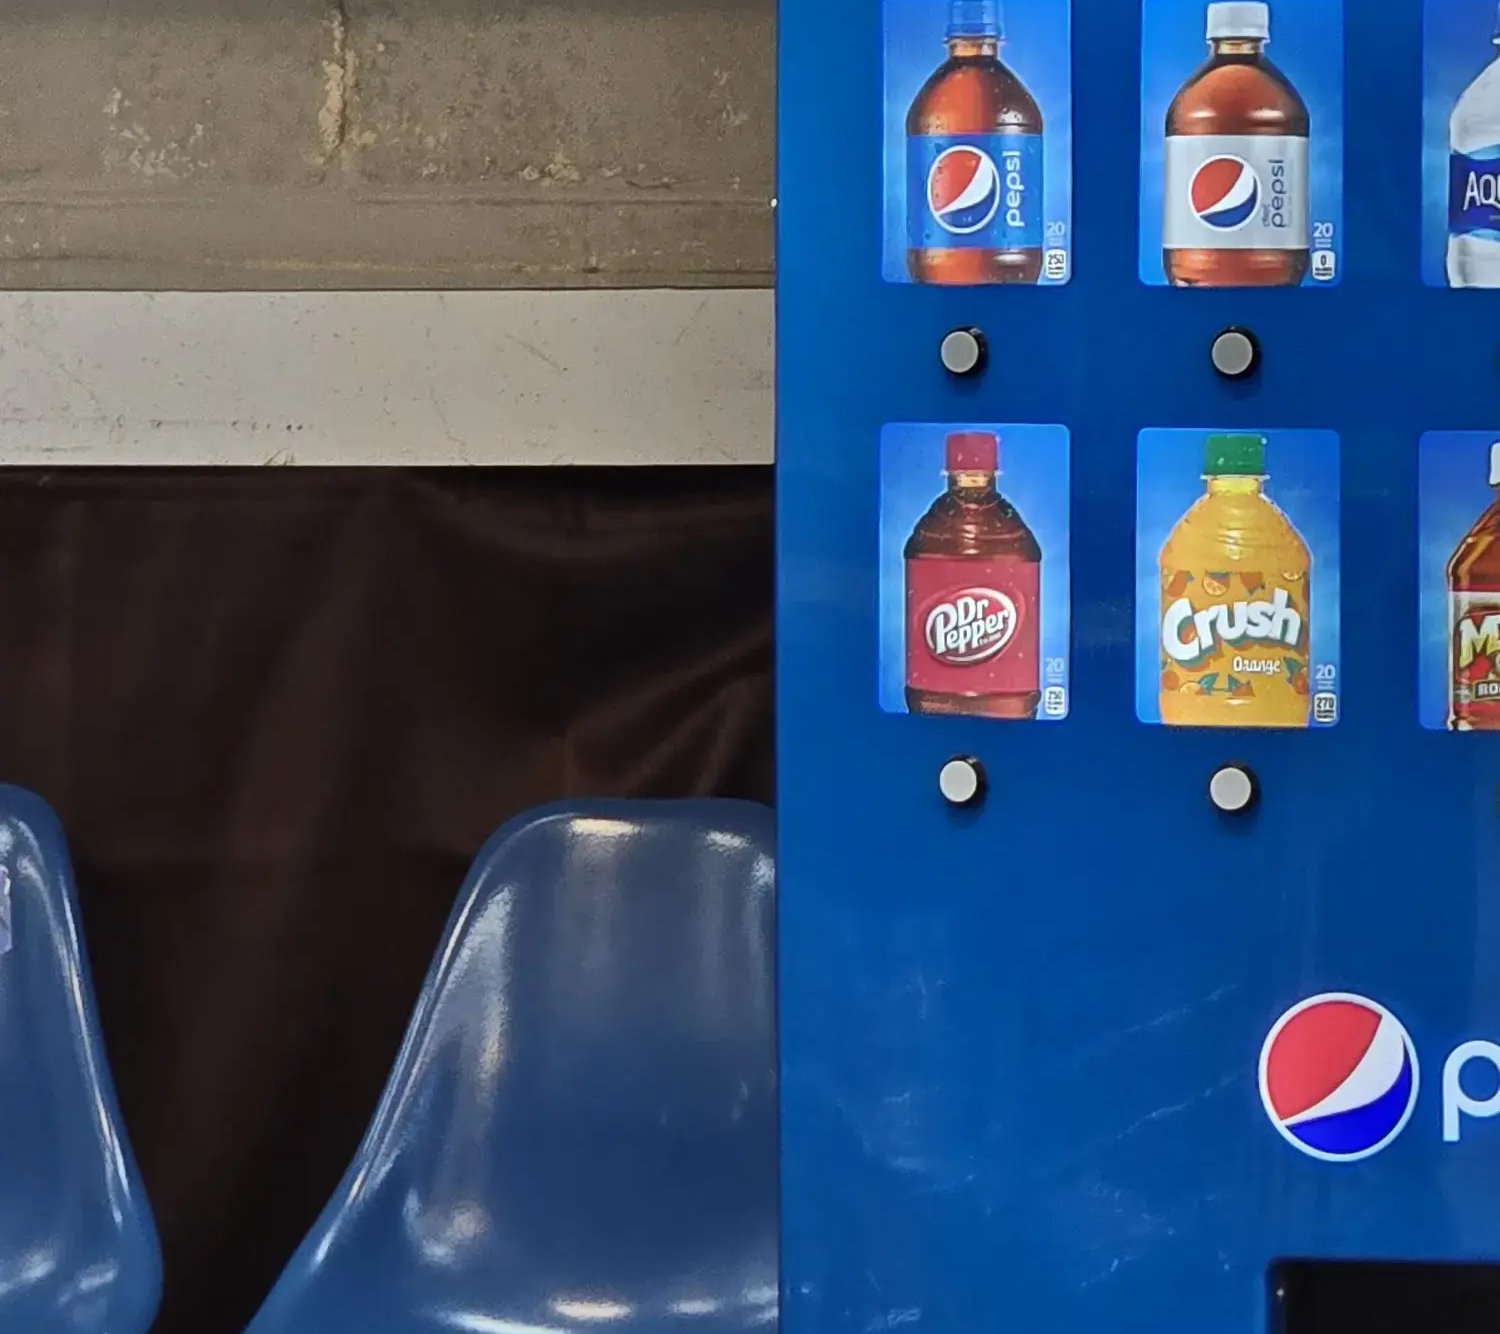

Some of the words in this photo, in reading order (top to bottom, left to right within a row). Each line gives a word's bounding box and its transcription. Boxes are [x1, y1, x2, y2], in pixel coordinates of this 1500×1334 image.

[1002, 150, 1024, 227] pepsi
[1268, 159, 1286, 228] pepsi
[1046, 222, 1065, 236] 20
[1313, 222, 1333, 238] 20
[1319, 254, 1327, 266] 0
[956, 596, 989, 627] Dr
[930, 603, 1009, 655] Pepper
[1162, 587, 1301, 661] Crush
[1046, 658, 1064, 672] 20
[1233, 656, 1281, 673] Orange
[1315, 665, 1335, 680] 20
[1316, 697, 1334, 710] 270
